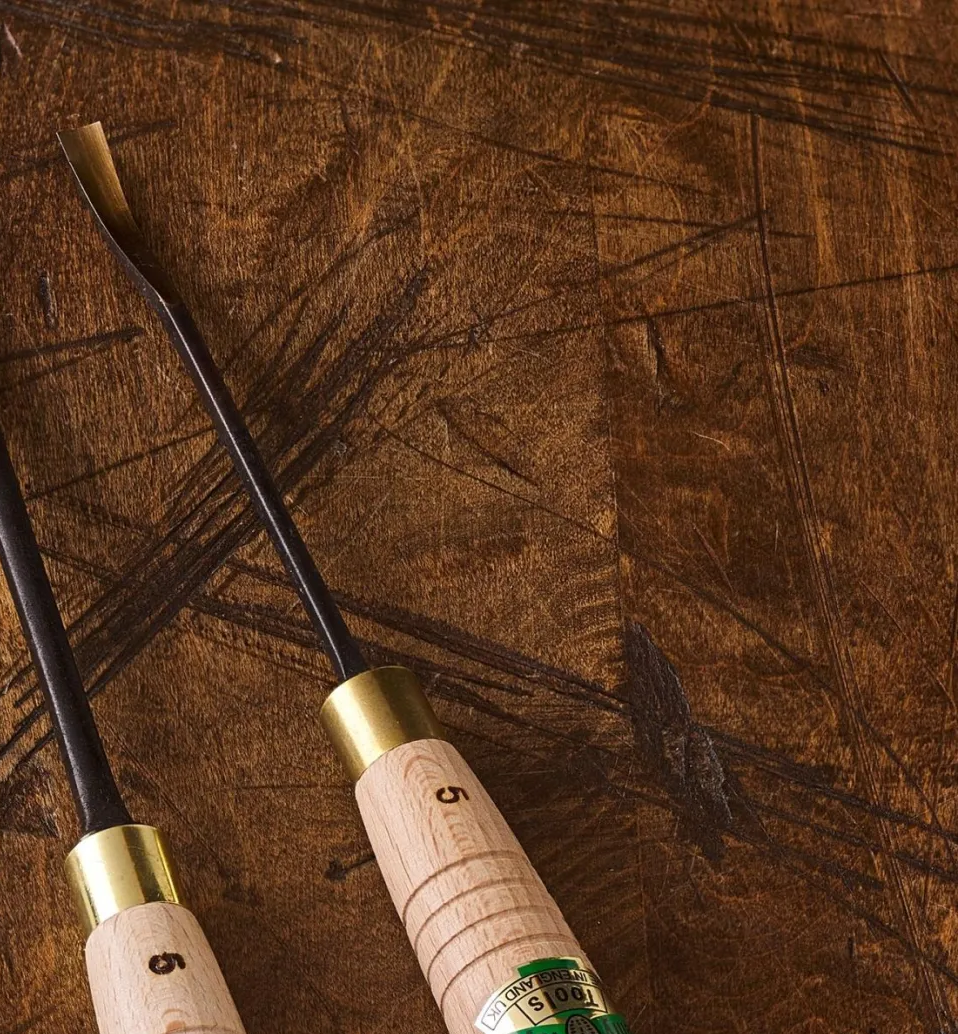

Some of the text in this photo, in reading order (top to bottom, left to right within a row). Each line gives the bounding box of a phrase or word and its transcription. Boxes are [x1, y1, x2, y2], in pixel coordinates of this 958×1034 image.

[505, 969, 573, 1002] ENGLAND
[528, 984, 599, 1012] Tools
[487, 1002, 506, 1023] UK
